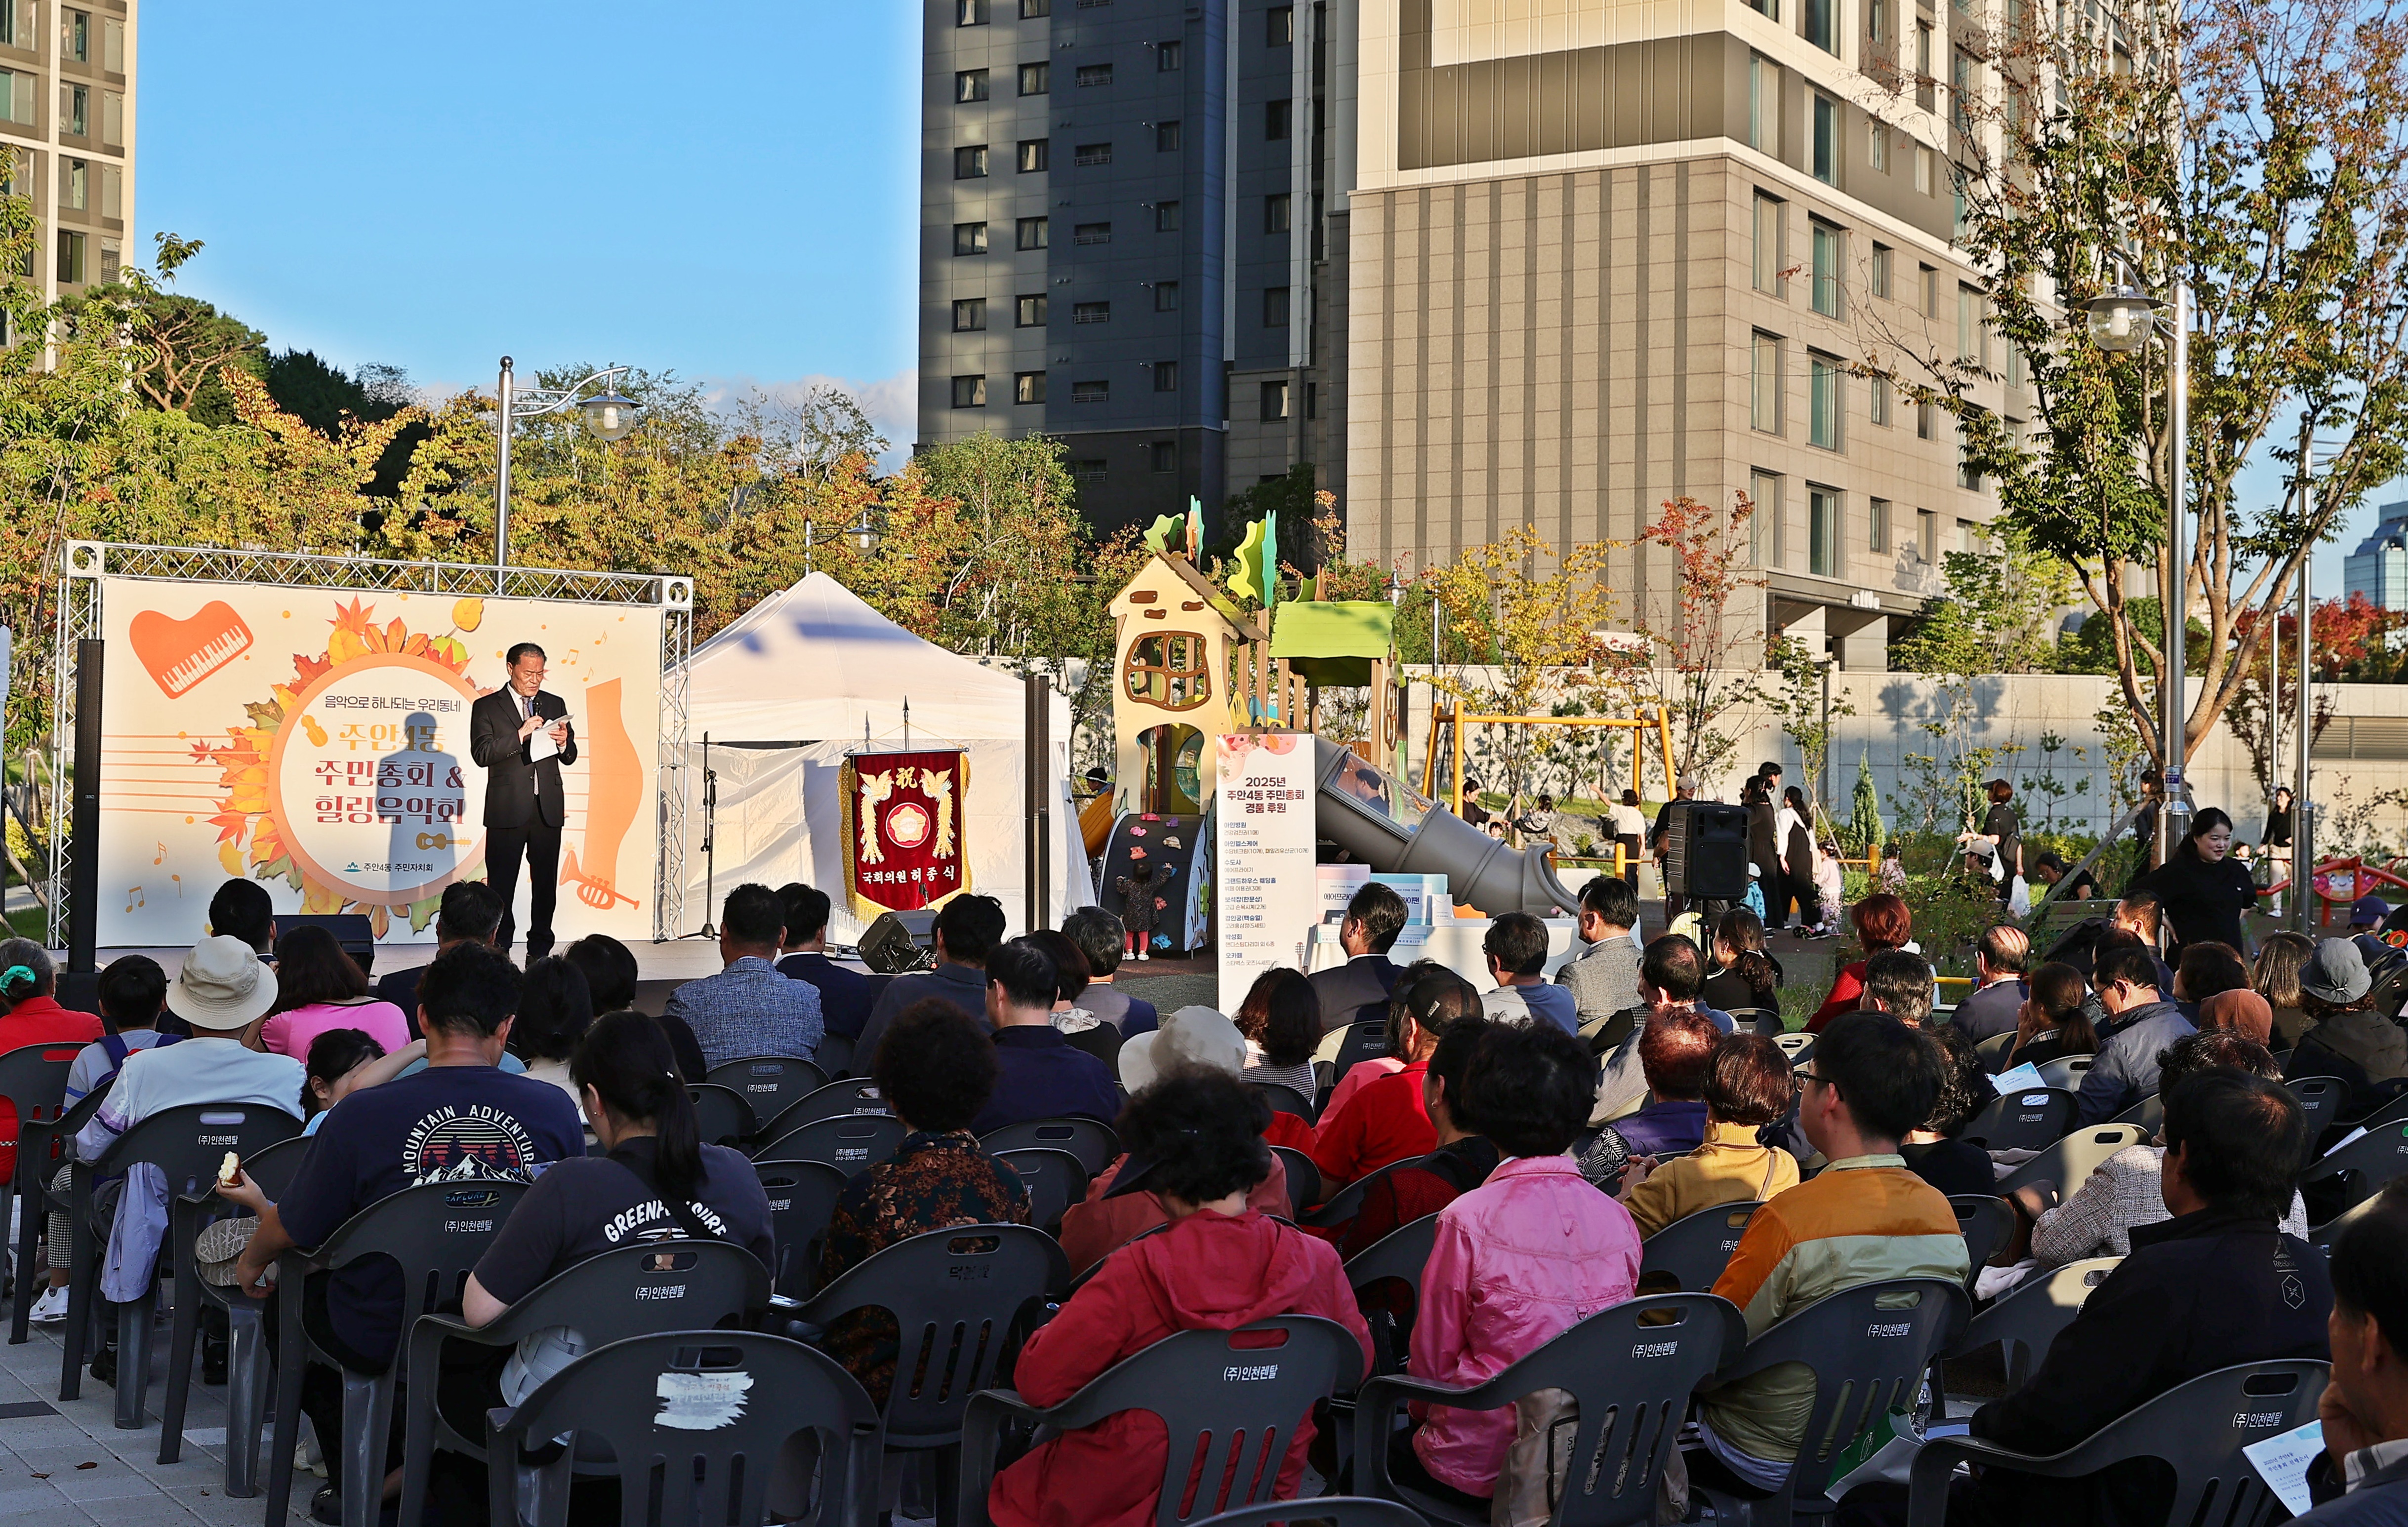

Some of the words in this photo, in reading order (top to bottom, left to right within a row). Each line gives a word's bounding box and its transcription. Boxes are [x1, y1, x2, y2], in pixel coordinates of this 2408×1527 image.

[325, 695, 368, 708] 음악으로
[372, 697, 415, 710] 하나되는
[418, 699, 460, 712] 우리동네
[339, 724, 446, 753] 주안4동
[315, 761, 435, 787] 주민총회
[446, 766, 467, 788] &
[896, 766, 917, 789] 祝
[1245, 777, 1286, 787] 2025년
[1227, 790, 1264, 800] 주안4동
[1266, 790, 1304, 800] 주민총회
[316, 796, 465, 825] 힐링음악회
[1245, 803, 1265, 813] 경품
[1267, 803, 1286, 813] 후원
[364, 863, 392, 872] 주안4동
[395, 863, 433, 872] 주민자치회
[862, 870, 907, 884] 국회의원
[747, 1083, 778, 1092] (주)인천렌탈
[2019, 1113, 2043, 1122] (주)인천렌탈
[198, 1135, 238, 1145] (주)인천렌탈
[403, 1105, 456, 1173] MOUNTAIN
[445, 1219, 493, 1232] (주)인천렌탈
[635, 1285, 686, 1300] (주)인천렌탈
[1868, 1323, 1911, 1337] (주)인천렌탈
[1632, 1341, 1678, 1358] (주)인천렌탈
[1224, 1364, 1278, 1381] (주)인천렌탈
[2233, 1411, 2283, 1428] (주)인천렌탈
